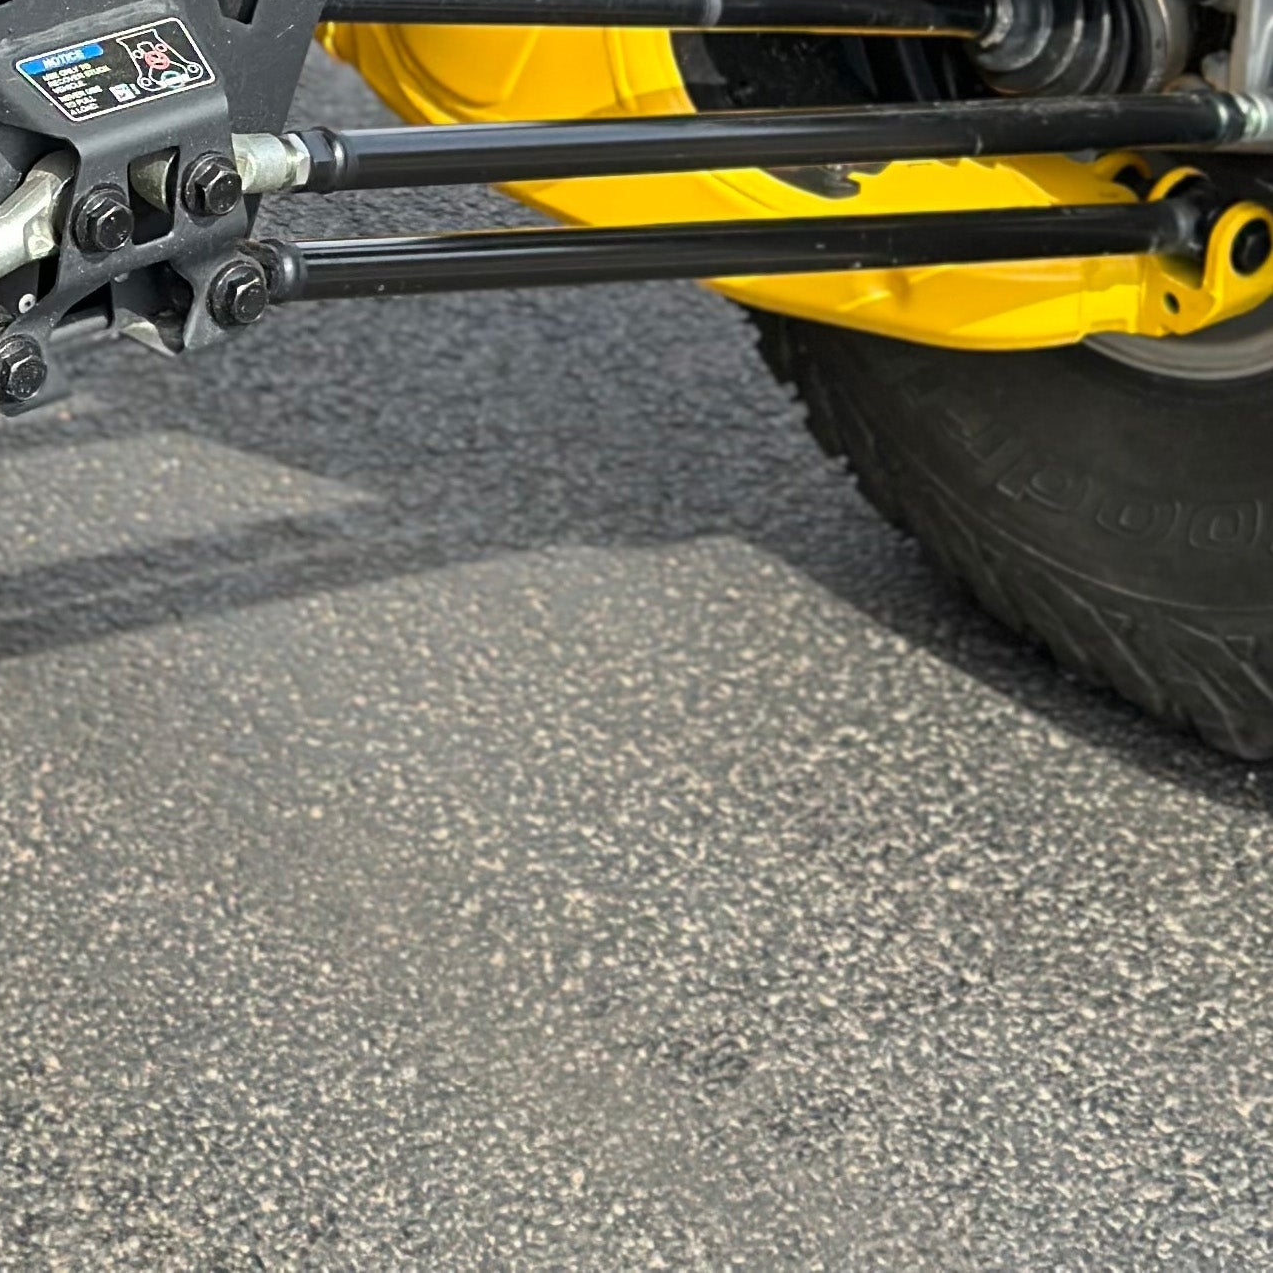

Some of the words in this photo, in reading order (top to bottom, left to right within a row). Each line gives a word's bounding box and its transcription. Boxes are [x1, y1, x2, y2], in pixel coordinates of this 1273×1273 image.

[42, 49, 85, 70] NOTICE
[47, 72, 85, 88] RECOVER
[84, 65, 112, 78] STUCK
[58, 66, 79, 77] ONLY
[78, 62, 92, 71] TO
[58, 90, 86, 103] NEVER
[75, 95, 97, 106] PULL
